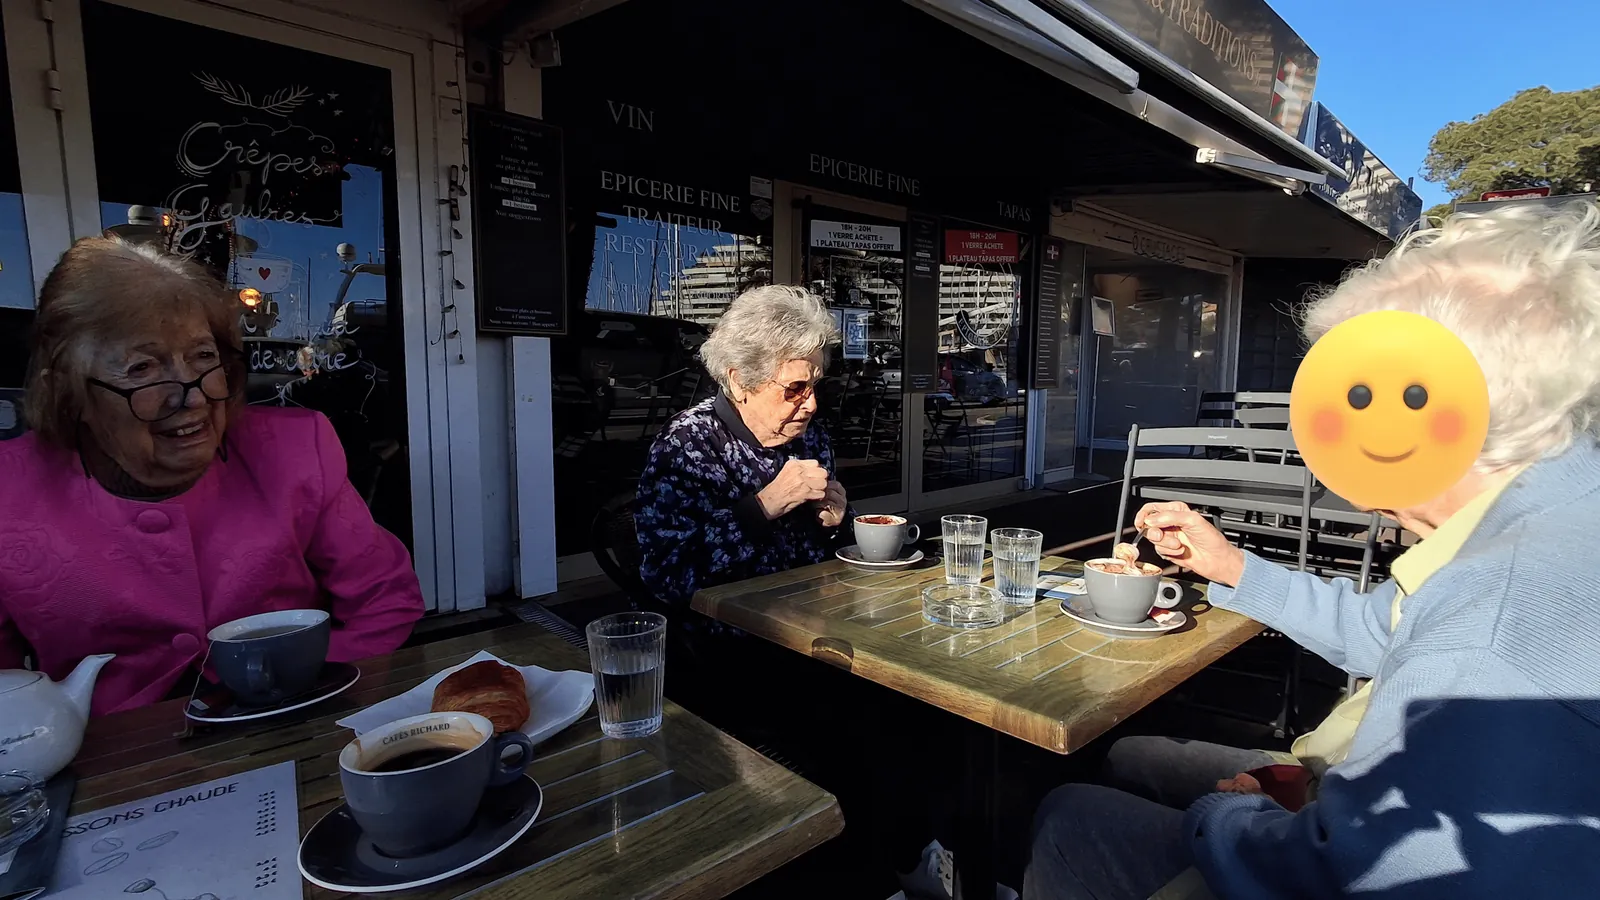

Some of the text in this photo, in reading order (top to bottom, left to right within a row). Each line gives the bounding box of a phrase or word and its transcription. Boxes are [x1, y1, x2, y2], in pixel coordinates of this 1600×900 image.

[1165, 0, 1257, 81] TRADITIONS
[606, 99, 656, 132] VIN
[177, 121, 331, 187] Crêpes
[809, 152, 921, 197] EPICERIE FINE
[600, 169, 695, 205] EPICERIE
[699, 189, 742, 213] FINE
[622, 204, 723, 237] TRAITEUR
[996, 200, 1031, 222] TAPAS
[831, 232, 853, 240] VERRE
[840, 223, 853, 231] 18H
[858, 224, 871, 232] 20H
[969, 232, 981, 240] 18H
[820, 239, 850, 248] PLATEAU
[850, 241, 871, 249] TAPAS
[410, 723, 450, 737] RICHARD
[154, 782, 240, 813] CHAUDE
